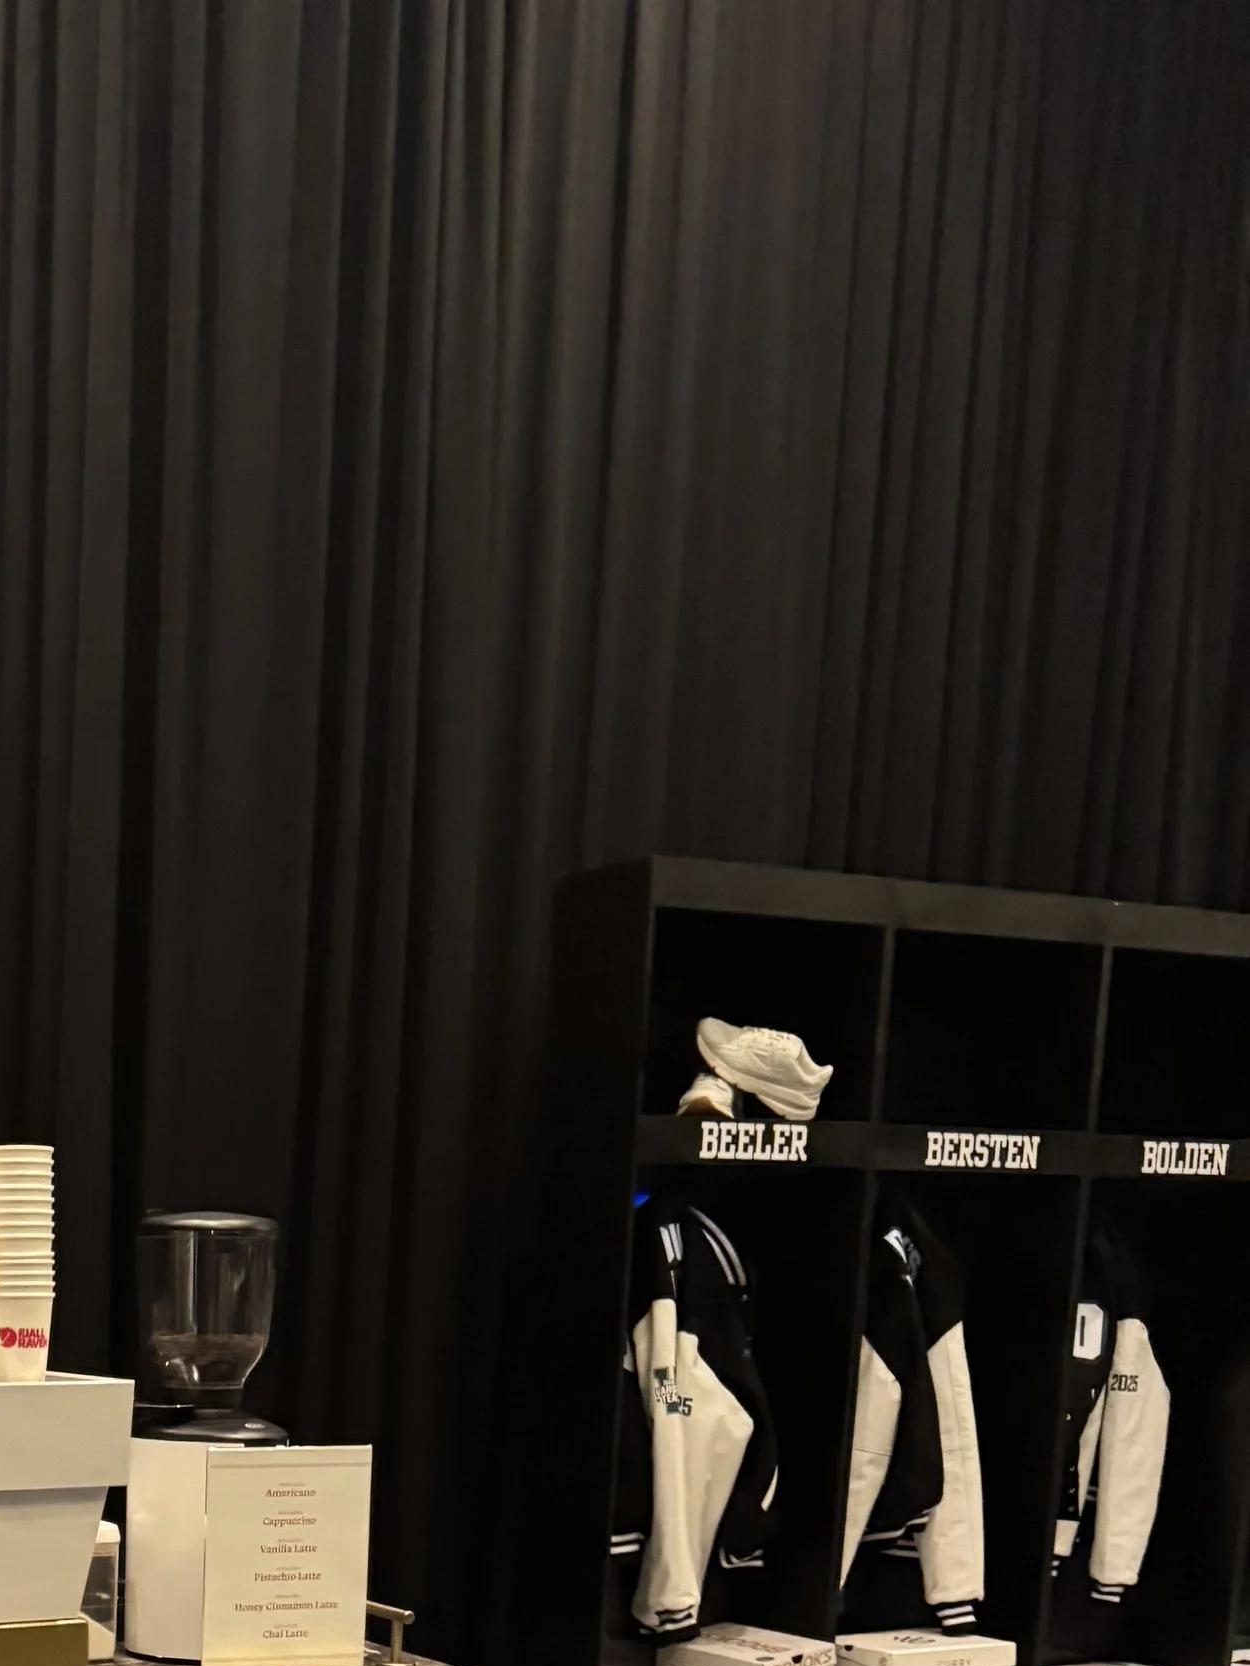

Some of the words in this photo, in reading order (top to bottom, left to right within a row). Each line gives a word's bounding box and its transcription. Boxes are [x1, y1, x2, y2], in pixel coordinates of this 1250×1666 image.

[699, 1121, 808, 1162] BEELER
[925, 1131, 1040, 1170] BERSTEN
[1141, 1141, 1230, 1176] BOLDEN
[265, 1488, 317, 1498] Americano
[262, 1516, 317, 1527] Cappuccino
[260, 1545, 292, 1554] Vanilla
[294, 1544, 317, 1553] Latte
[254, 1572, 297, 1582] Pistachio
[298, 1571, 321, 1581] Latte
[234, 1602, 264, 1612] Honey
[266, 1601, 314, 1611] Cinnamon
[315, 1600, 338, 1609] Latte
[285, 1629, 308, 1638] Latte
